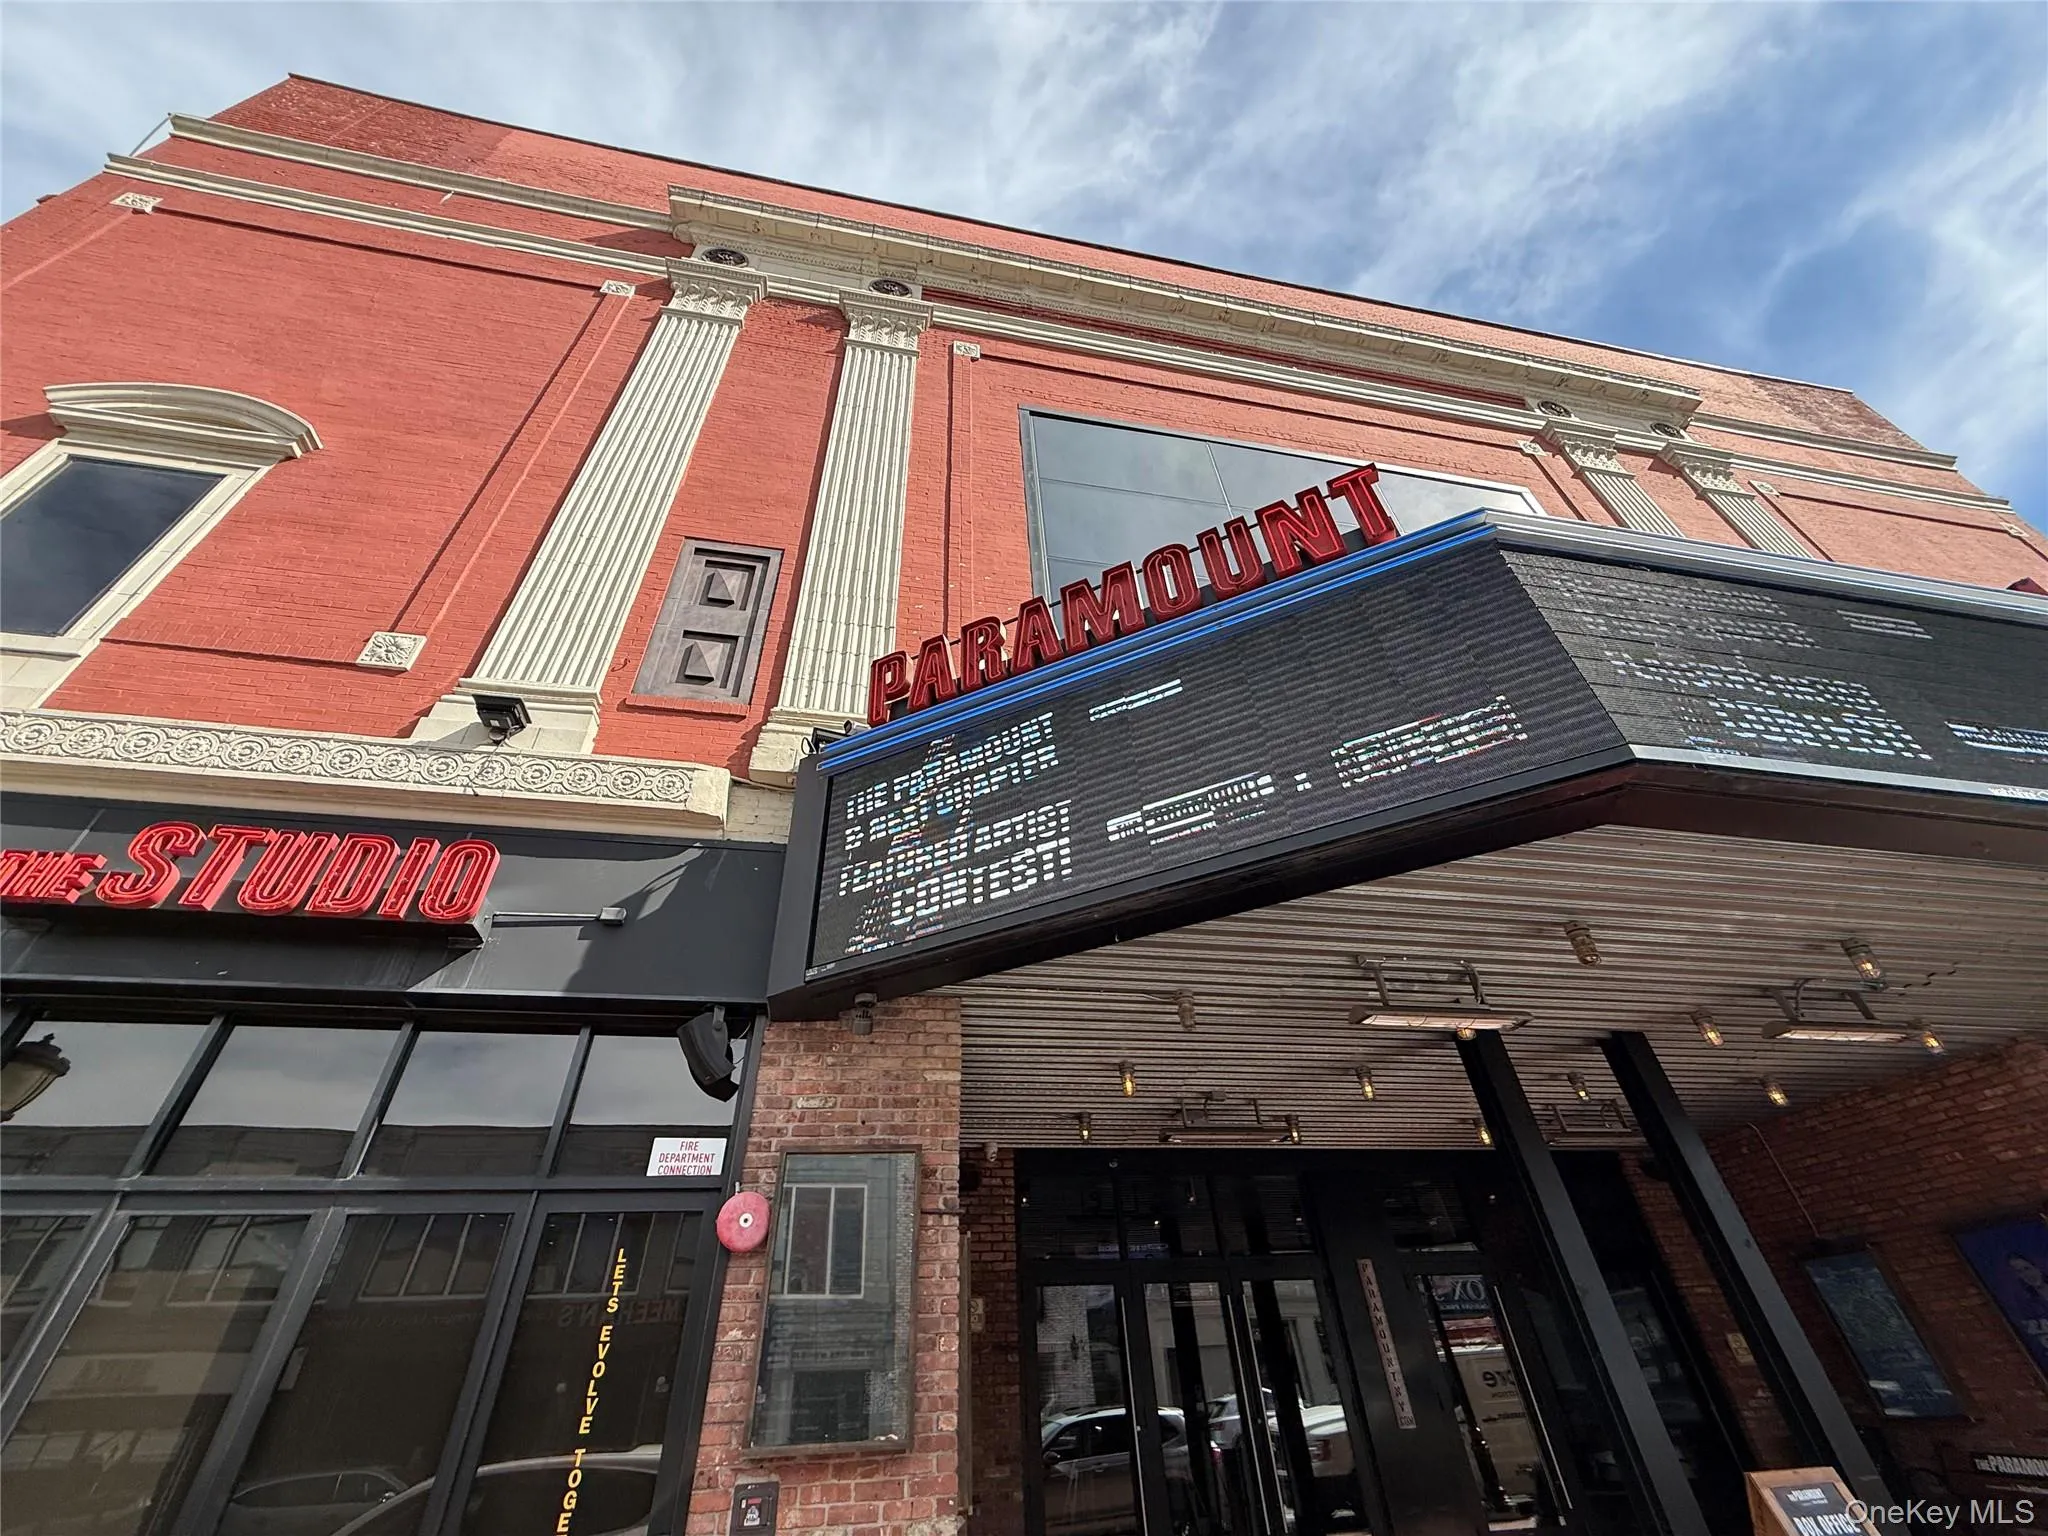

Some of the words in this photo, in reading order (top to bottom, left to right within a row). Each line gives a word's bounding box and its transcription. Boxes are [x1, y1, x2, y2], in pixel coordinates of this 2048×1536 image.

[867, 463, 1396, 727] PARAMOUNT
[0, 849, 107, 904] THE
[96, 820, 500, 922] STUDIO
[658, 1165, 712, 1175] CONNECTION
[659, 1153, 715, 1163] DEPARTMENT
[680, 1141, 699, 1151] FIRE
[607, 1248, 626, 1313] LETS
[579, 1325, 612, 1434] EVOLVE
[556, 1449, 586, 1536] TOGE
